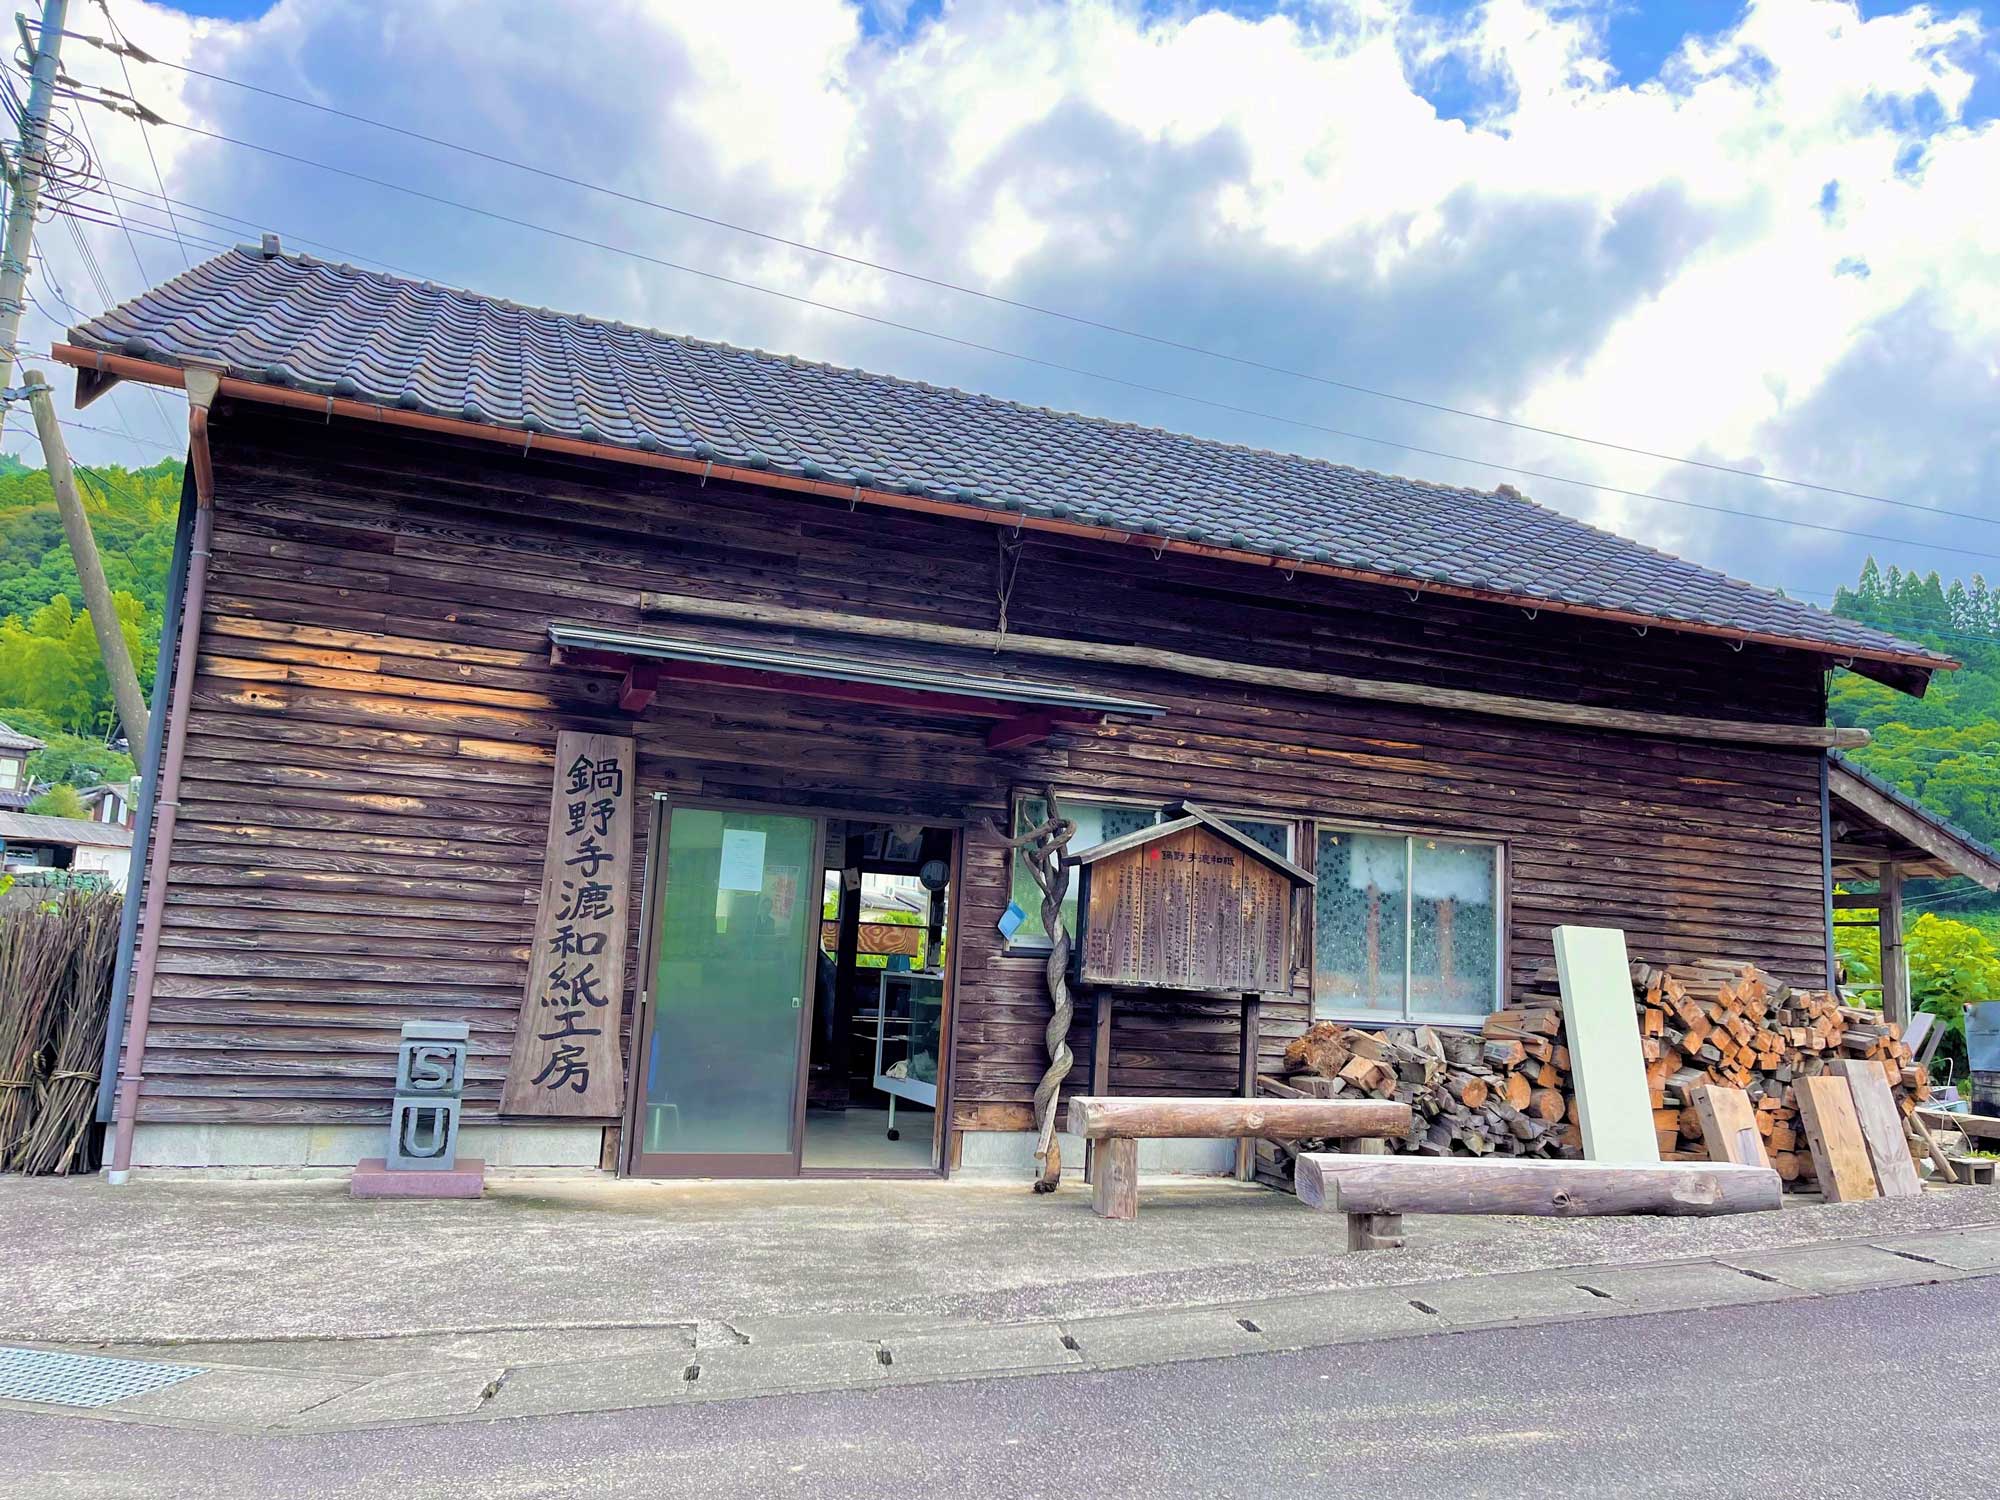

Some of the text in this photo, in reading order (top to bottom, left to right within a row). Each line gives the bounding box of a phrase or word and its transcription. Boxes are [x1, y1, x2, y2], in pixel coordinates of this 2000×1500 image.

[530, 753, 623, 1094] 鍋野手漉和紙工房
